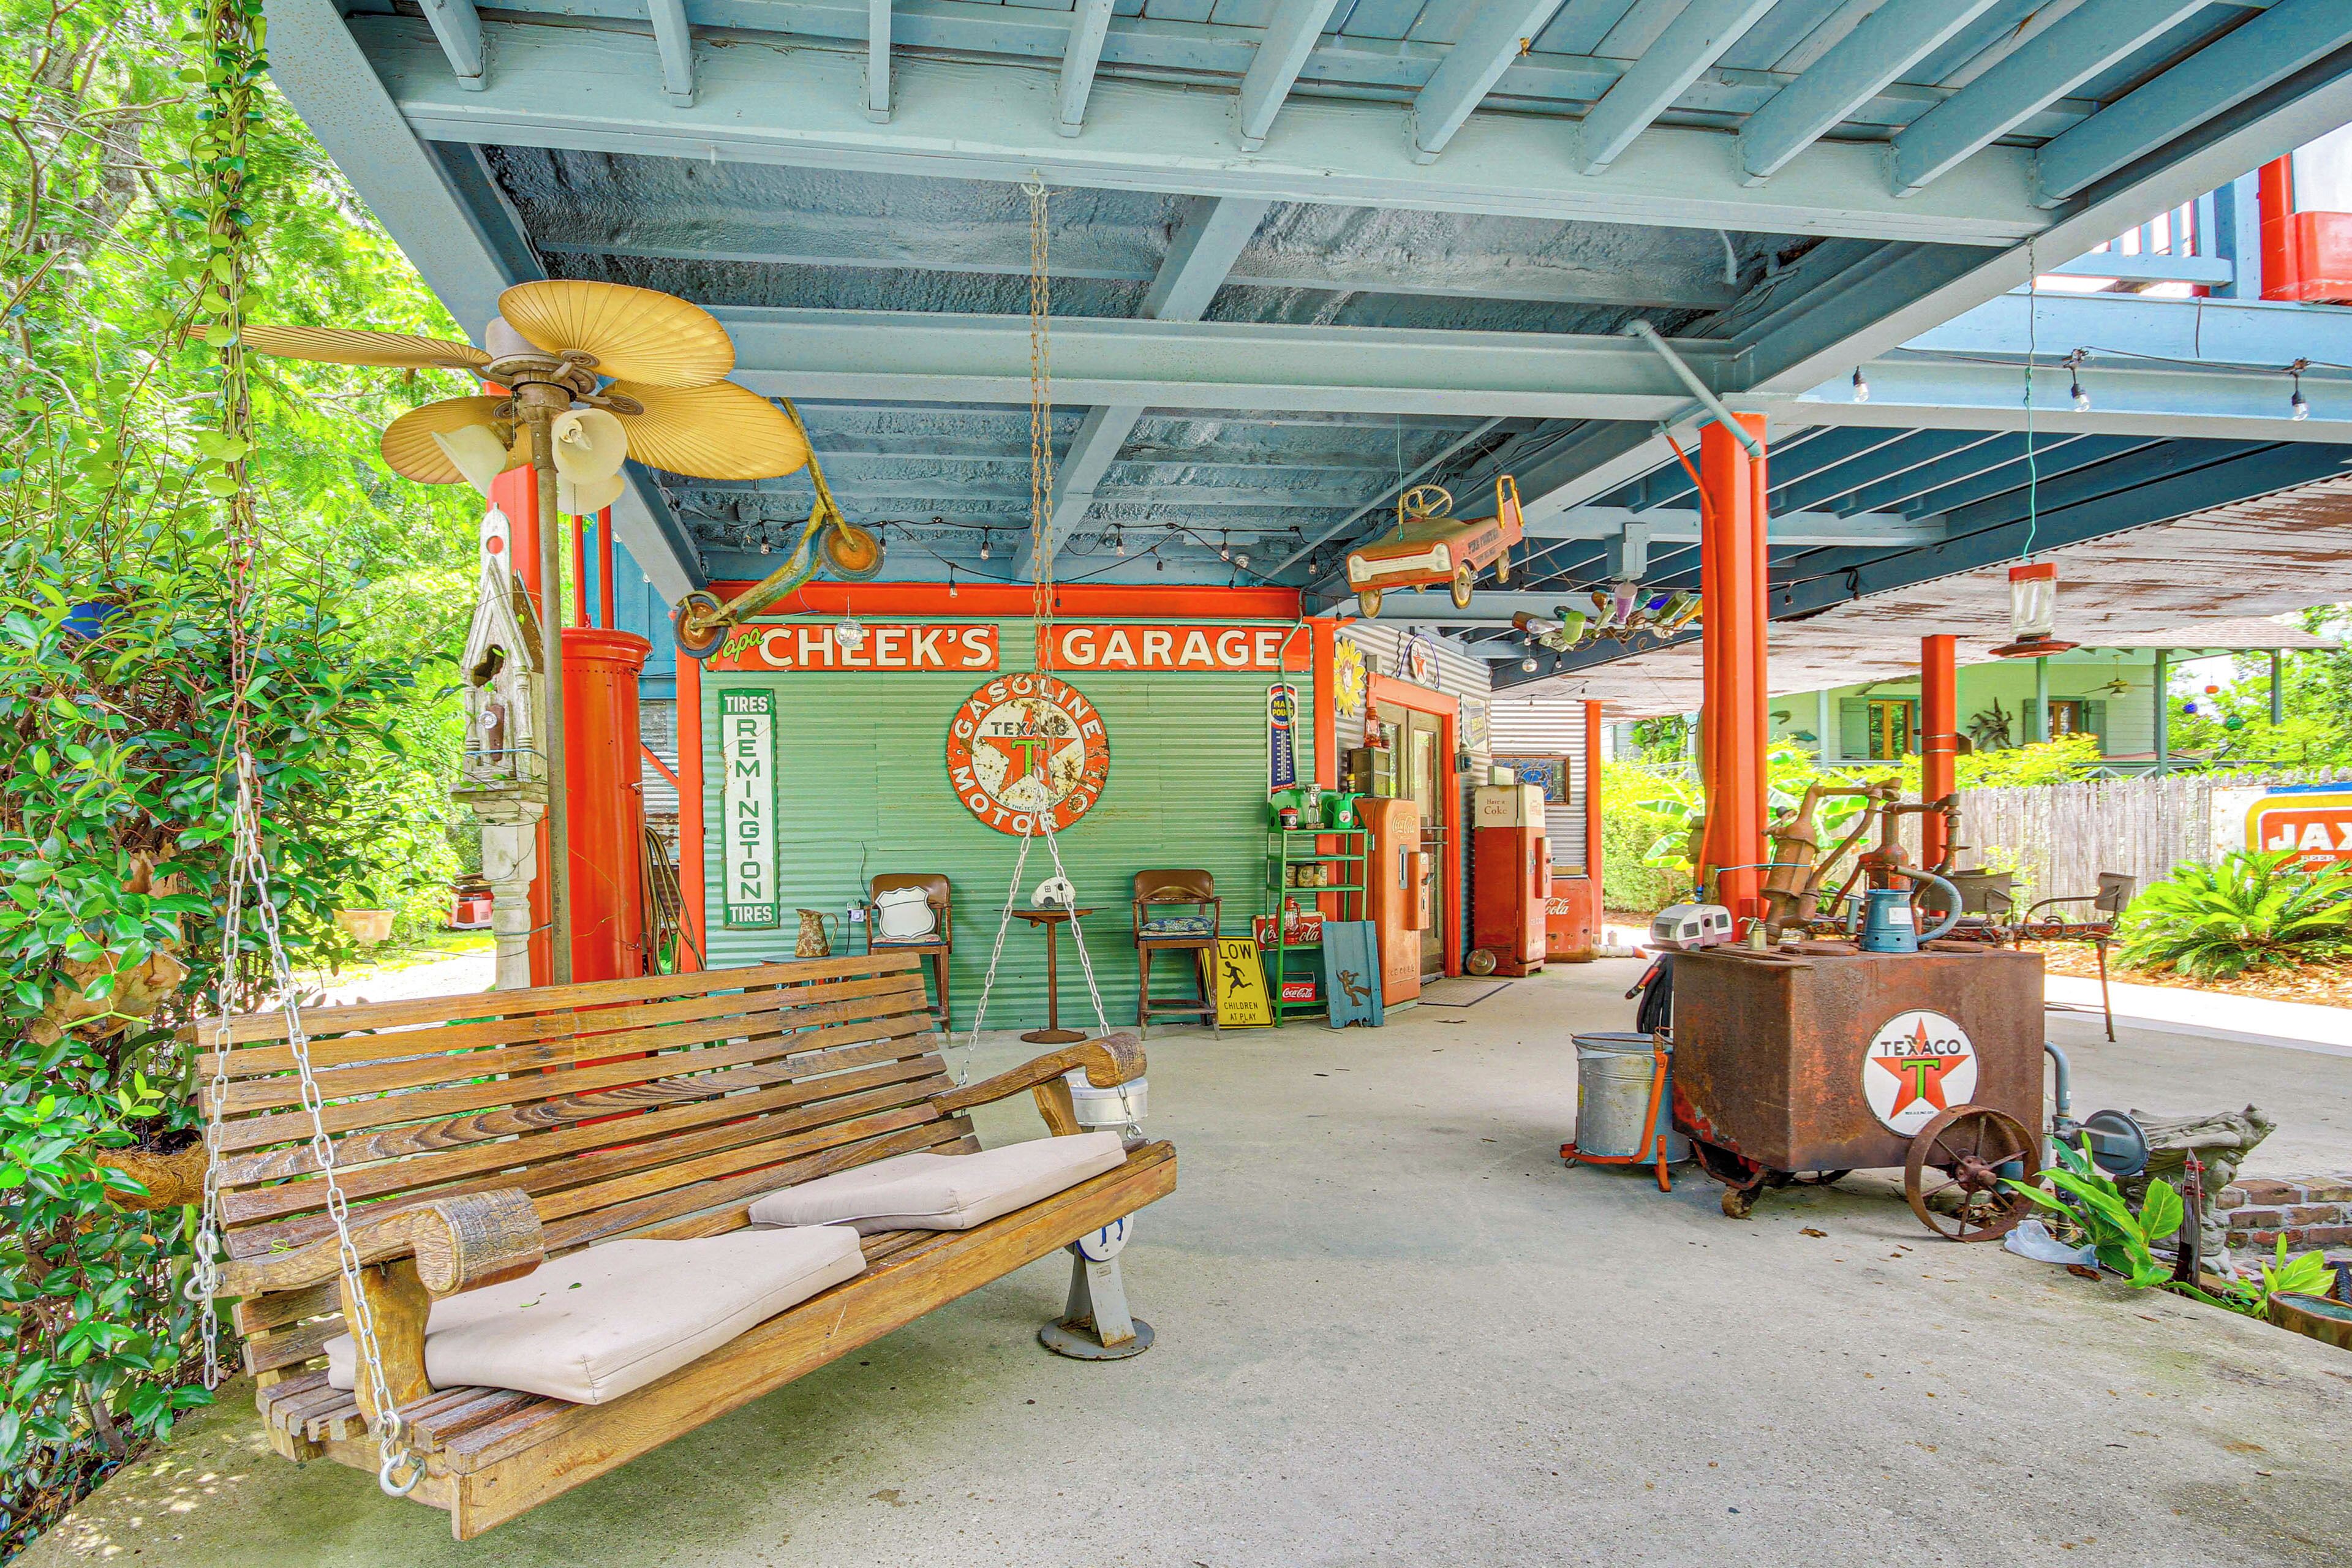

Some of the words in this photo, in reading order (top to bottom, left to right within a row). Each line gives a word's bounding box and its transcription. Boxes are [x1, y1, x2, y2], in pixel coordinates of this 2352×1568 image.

[758, 628, 992, 667] CHEEK'S
[1061, 628, 1283, 666] GARAGE
[725, 696, 767, 712] TIRES
[954, 676, 1102, 739] GASOLINE
[736, 719, 761, 900] REMINGTON
[952, 766, 1059, 833] MOTOR
[1484, 805, 1507, 815] Coke
[729, 906, 772, 922] TIRES
[1283, 987, 1313, 998] Coca-Cola
[1880, 1039, 1961, 1056] TEXACO
[1901, 1058, 1940, 1099] T
